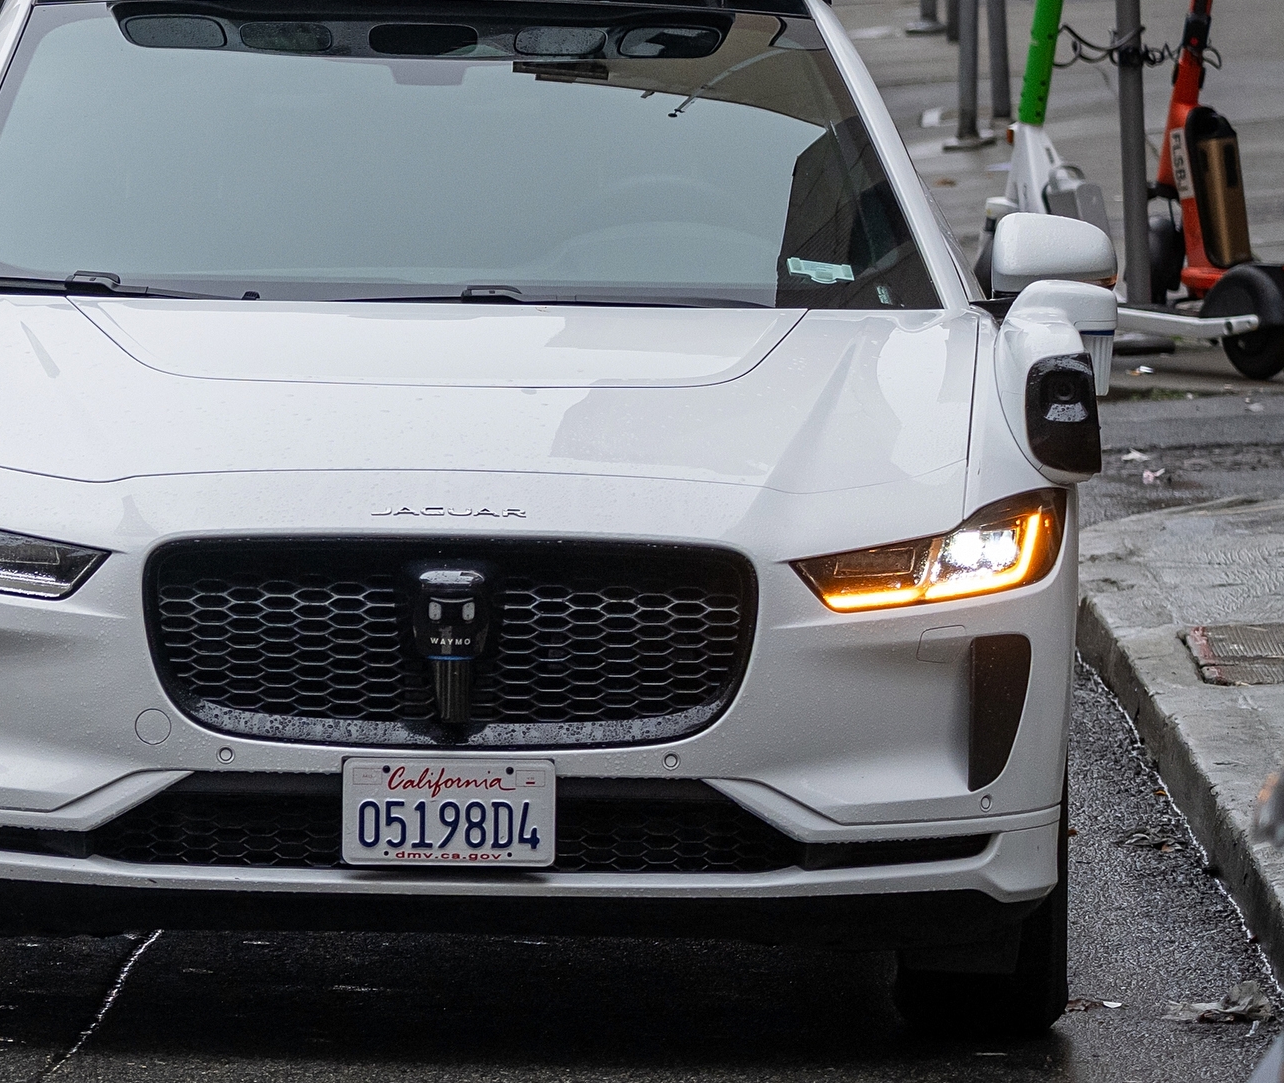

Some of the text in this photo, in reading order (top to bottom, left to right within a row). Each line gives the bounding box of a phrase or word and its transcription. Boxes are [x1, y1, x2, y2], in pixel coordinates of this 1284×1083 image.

[370, 506, 527, 519] JAGUAR
[429, 636, 472, 646] WAYMO
[387, 766, 517, 798] California
[357, 800, 541, 850] 05198D4
[394, 850, 502, 862] dmv.ca.gov
